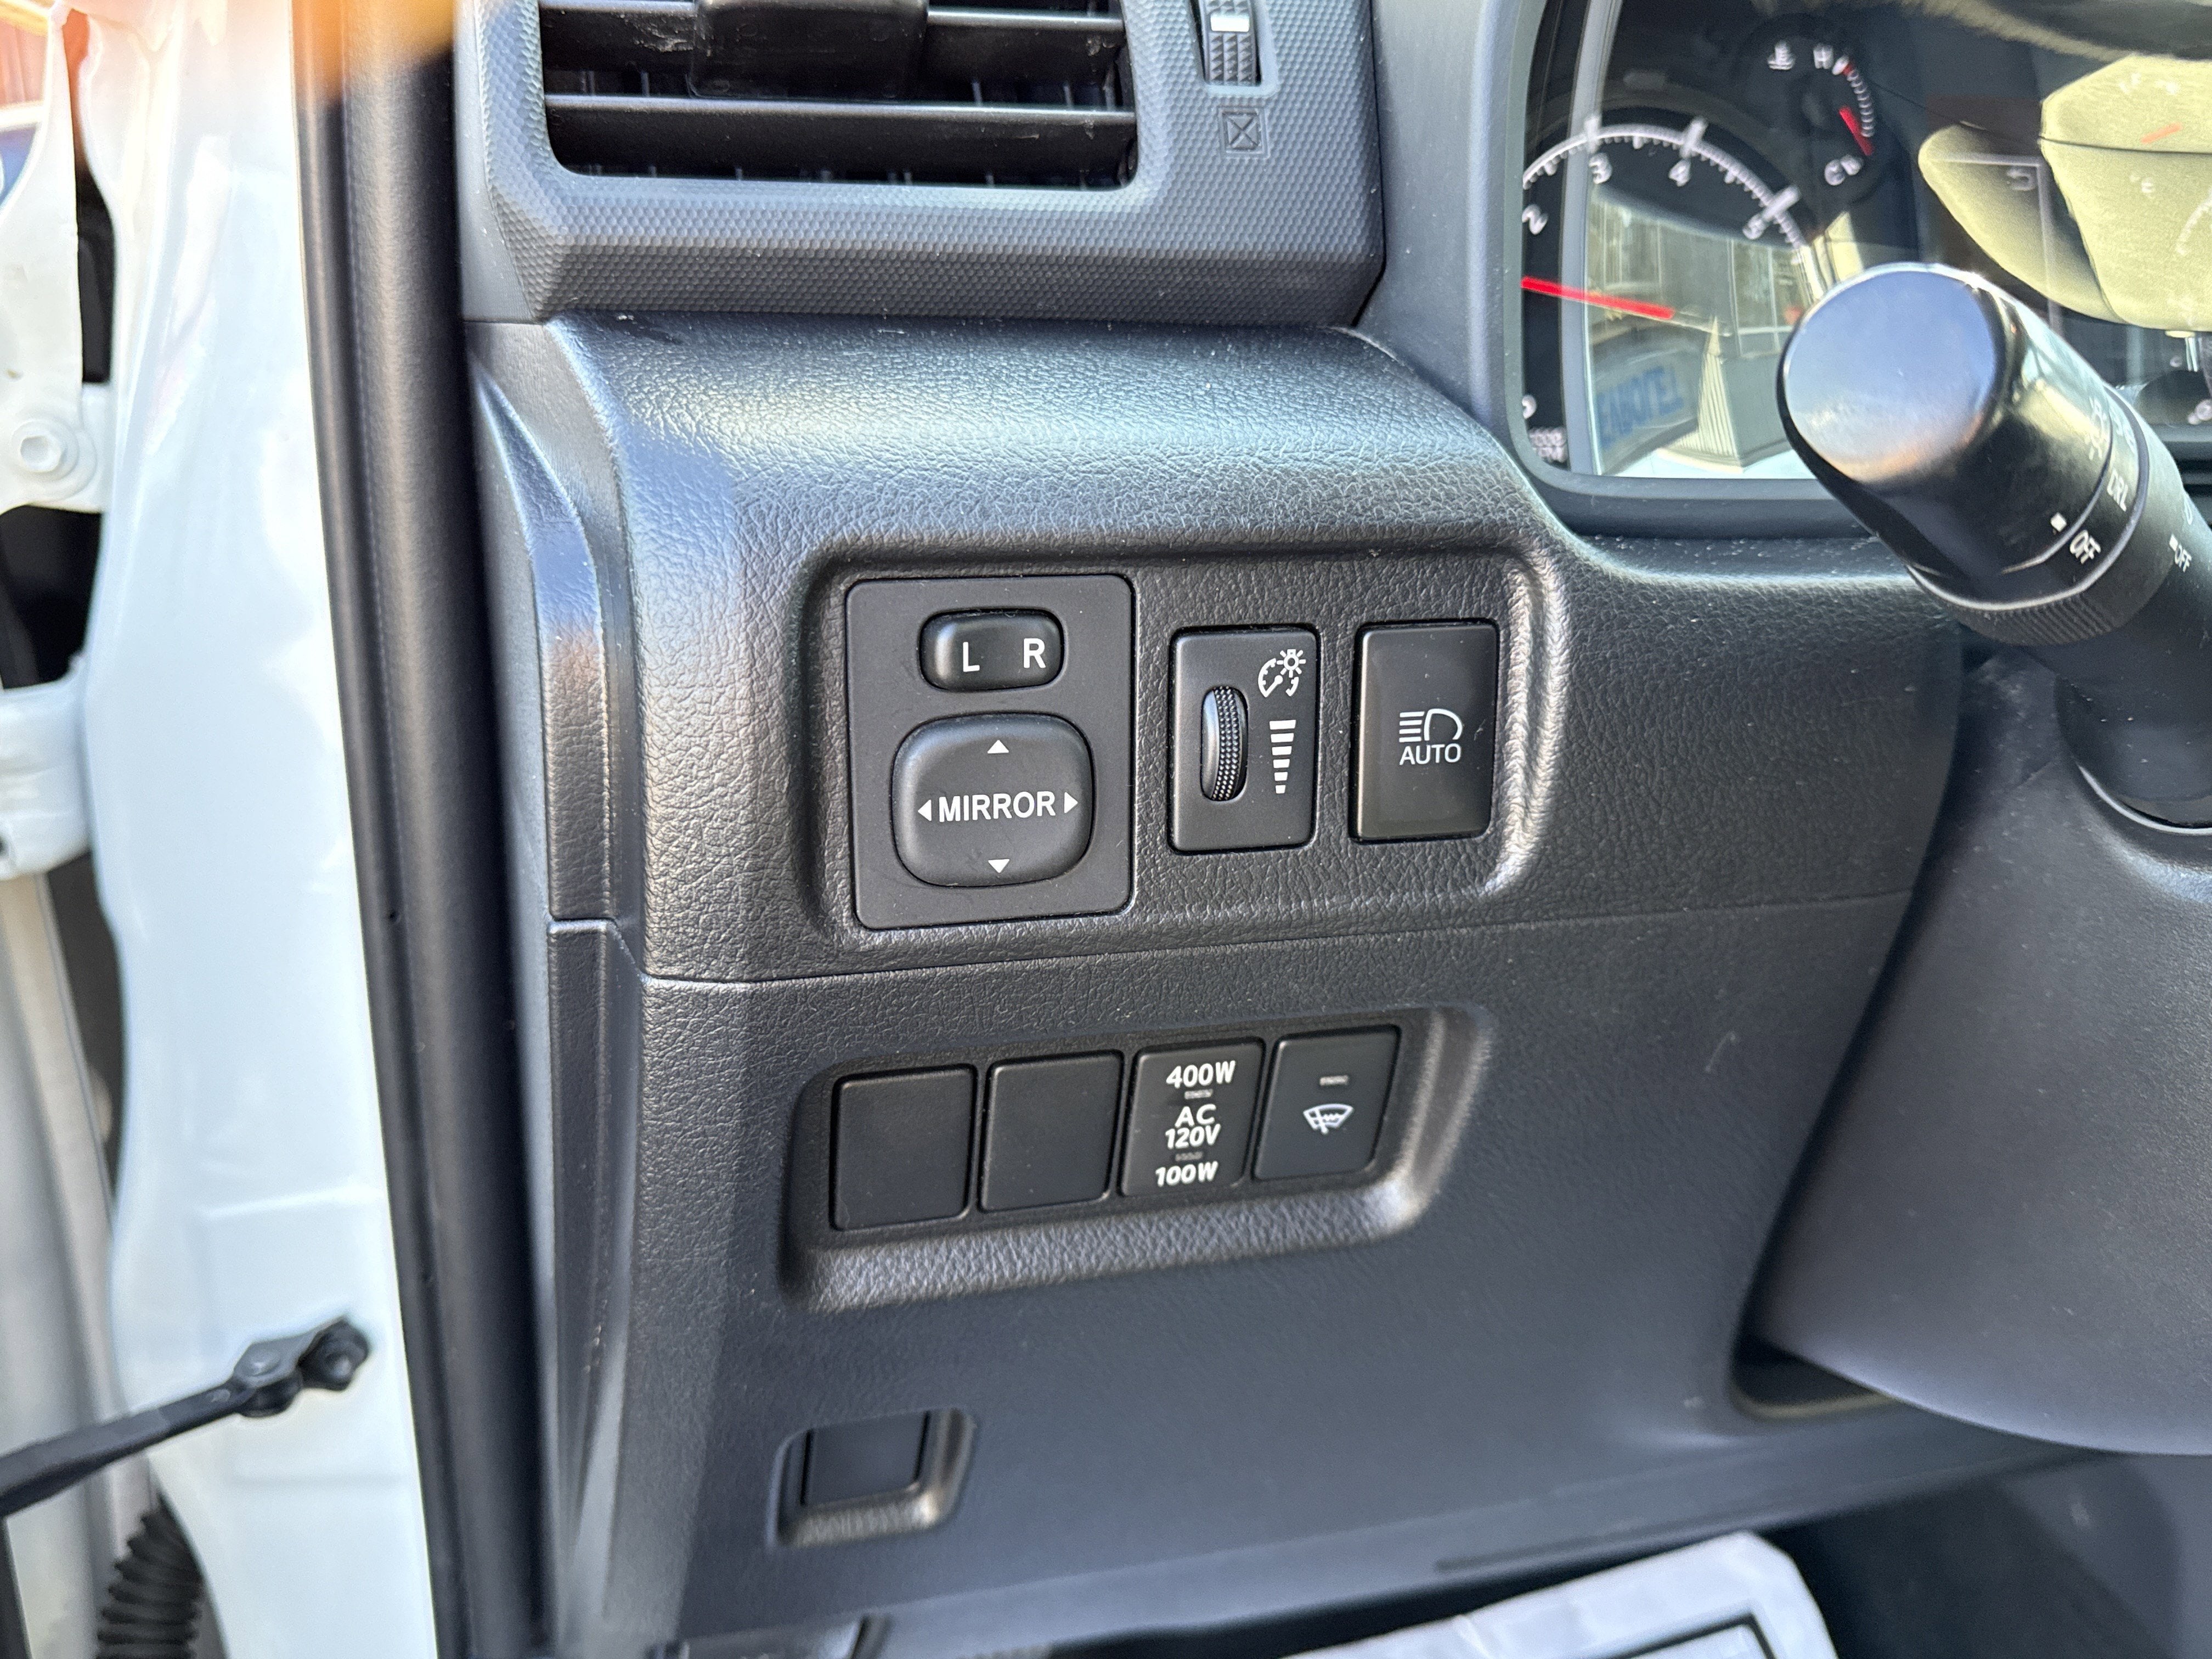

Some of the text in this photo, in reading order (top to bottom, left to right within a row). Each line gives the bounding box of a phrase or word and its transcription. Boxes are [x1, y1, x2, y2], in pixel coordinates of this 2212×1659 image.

[1590, 153, 1612, 184] 3
[1668, 160, 1691, 187] 4
[1522, 204, 1548, 235] 2
[2107, 468, 2128, 512] DRL
[2069, 529, 2101, 565] OFF
[2174, 543, 2192, 573] OFF
[962, 637, 1046, 673] L R
[1398, 741, 1462, 766] AUTO
[938, 790, 1056, 823] MIRROR
[1166, 1060, 1236, 1089] 400W
[1174, 1103, 1217, 1128] AC
[1165, 1123, 1221, 1149] 120V
[1155, 1161, 1218, 1187] 100W
